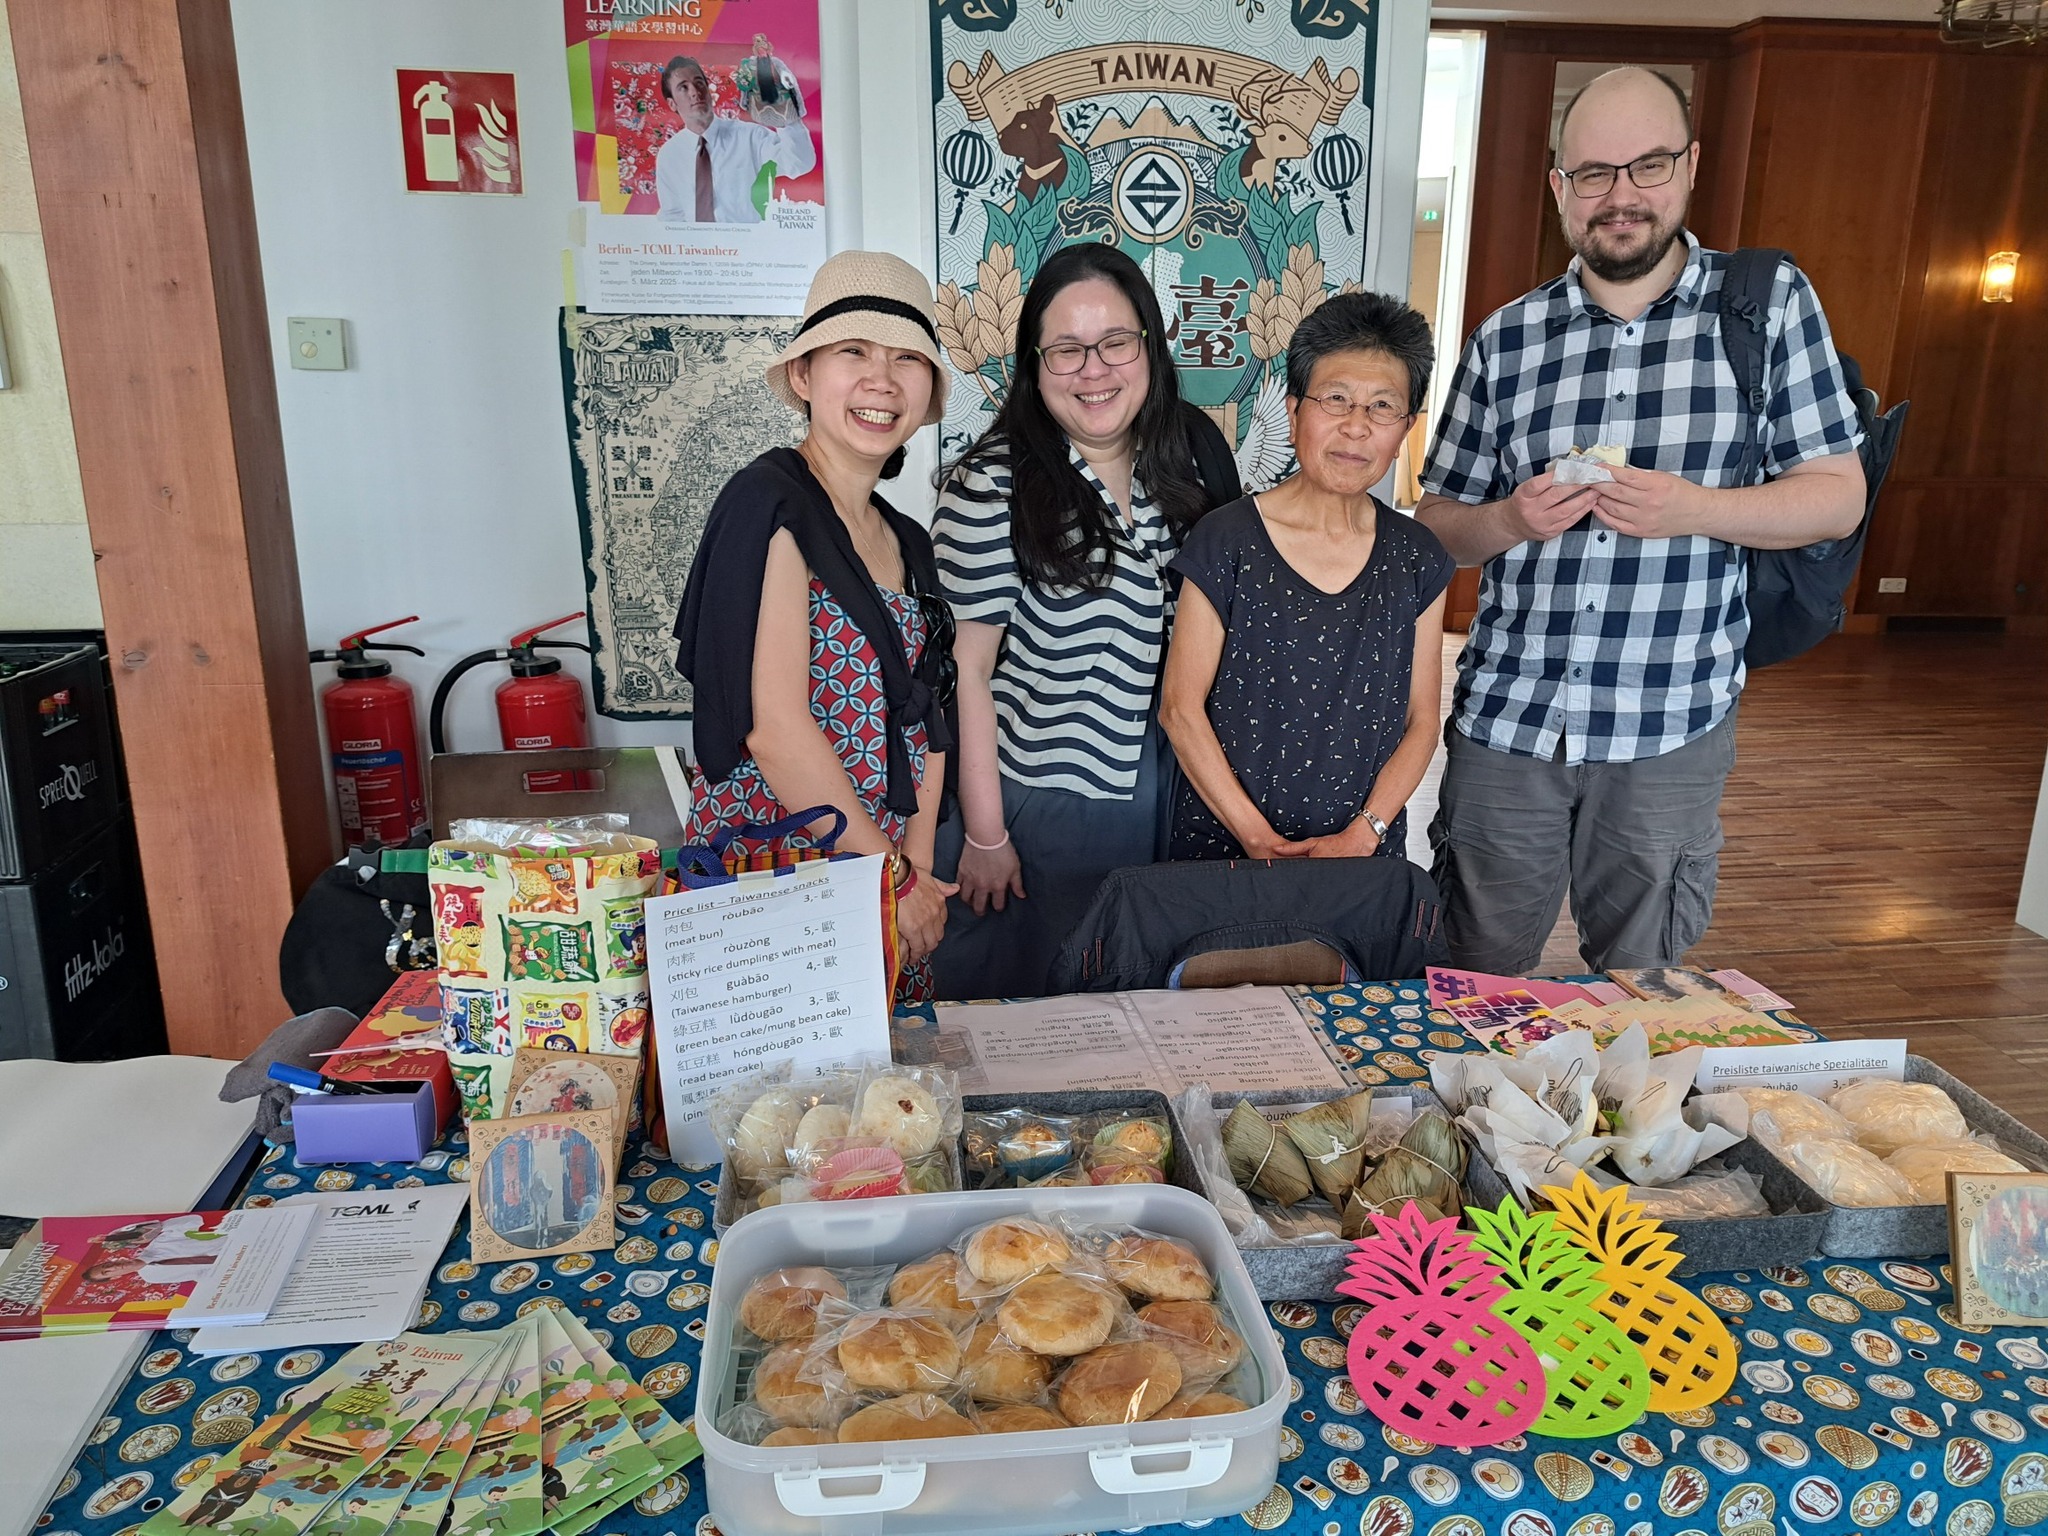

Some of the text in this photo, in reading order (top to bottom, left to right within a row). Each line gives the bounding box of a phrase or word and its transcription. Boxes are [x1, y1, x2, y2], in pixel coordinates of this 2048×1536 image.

[585, 0, 701, 17] LEARNING
[1090, 52, 1218, 87] TAIWAN
[778, 220, 814, 229] TAIWAN
[599, 244, 632, 255] Berlin
[641, 244, 675, 255] TCML
[676, 245, 740, 256] Taiwanherz
[343, 741, 380, 749] GLORIA
[516, 737, 550, 747] GLORIA
[664, 907, 694, 918] Price
[697, 902, 714, 910] list
[729, 887, 790, 904] Taiwanese
[793, 877, 829, 891] snacks
[665, 921, 693, 936] 肉包
[722, 906, 764, 920] ròubāo
[803, 894, 818, 902] 3,-
[665, 928, 723, 950] (meat bun)
[723, 937, 771, 953] ròuzòng
[804, 926, 818, 935] 5,-
[668, 938, 836, 984] (sticky rice dumplings with meat)
[726, 973, 769, 991] guàbāo
[806, 961, 821, 971] 4,-
[671, 984, 792, 1019] (Taiwanese hamburger)
[809, 996, 823, 1006] 3,-
[675, 1006, 851, 1053] (green bean cake/mung bean cake)
[812, 1031, 826, 1040] 3,-
[679, 1060, 764, 1087] (read bean cake)
[1713, 1058, 1888, 1077] Preisliste taiwanische Spezialitäten
[330, 1203, 395, 1218] TCML
[7, 1244, 60, 1302] MANDARIN
[9, 1265, 59, 1316] LEARNING
[410, 1345, 464, 1361] Taiwan
